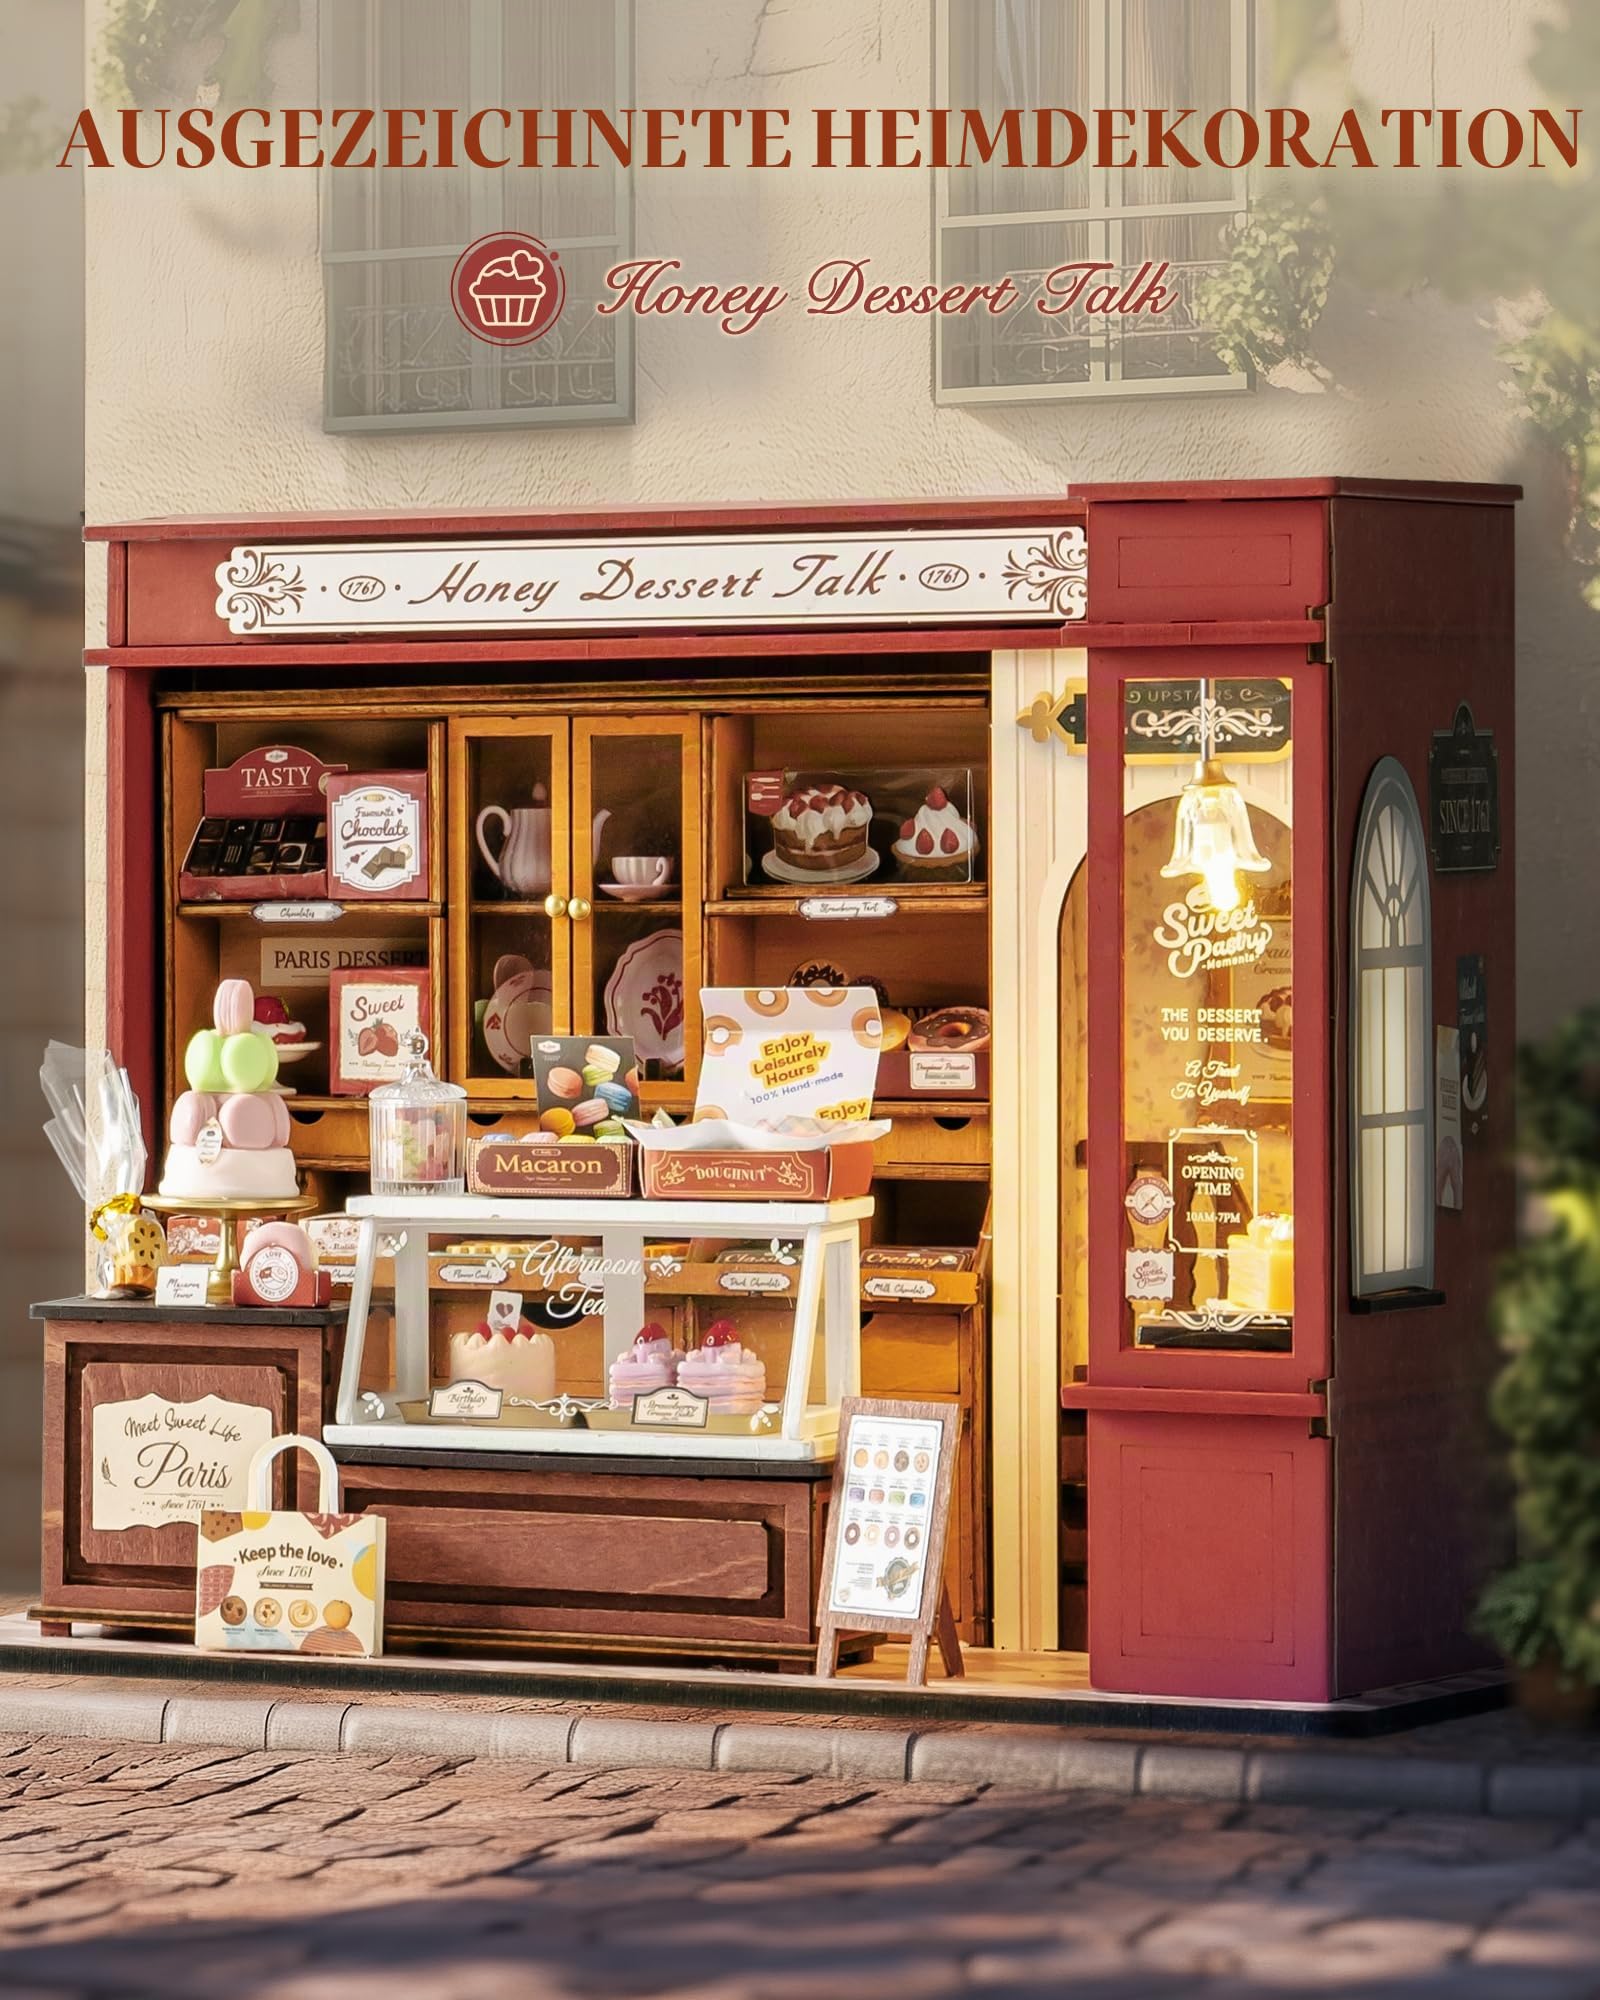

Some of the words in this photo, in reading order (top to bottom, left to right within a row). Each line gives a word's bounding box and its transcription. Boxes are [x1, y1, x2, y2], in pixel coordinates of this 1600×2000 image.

[345, 582, 377, 596] 1761
[408, 560, 560, 612] Honey
[579, 557, 764, 601] Dessert
[772, 549, 895, 599] Talk
[925, 569, 960, 585] 1761
[1147, 688, 1233, 702] UPSTARS
[241, 765, 312, 788] TASTY
[340, 818, 410, 841] Chocolate
[1153, 899, 1258, 949] Sweet
[274, 950, 331, 969] PARIS
[1167, 921, 1273, 979] Pastry
[350, 994, 405, 1021] Sweet
[1161, 1007, 1189, 1023] THE
[1197, 1008, 1262, 1024] DESSERT
[763, 1034, 811, 1056] Enjoy
[1161, 1027, 1190, 1042] YOU
[1197, 1027, 1269, 1043] DESERVE.
[753, 1044, 827, 1075] Leisurely
[766, 1063, 816, 1086] Hours
[750, 1089, 779, 1105] 100%
[818, 1102, 868, 1120] Enjoy
[494, 1153, 603, 1174] Macaron
[696, 1166, 766, 1182] DOUGHNUT
[1181, 1165, 1245, 1181] OPENING
[1195, 1181, 1232, 1196] TIME
[521, 1239, 643, 1288] Afternoon
[866, 1253, 940, 1268] Creamy
[873, 1282, 891, 1294] Milk
[545, 1282, 609, 1319] Tea
[124, 1412, 161, 1438] Meet
[164, 1407, 206, 1432] Sweet
[209, 1416, 242, 1442] Life
[134, 1440, 233, 1489] Paris
[161, 1499, 184, 1511] Since
[186, 1499, 206, 1511] 1761
[239, 1547, 277, 1565] Keep
[279, 1542, 305, 1560] the
[306, 1545, 338, 1569] love
[256, 1564, 285, 1578] Since
[287, 1564, 314, 1579] 1761
